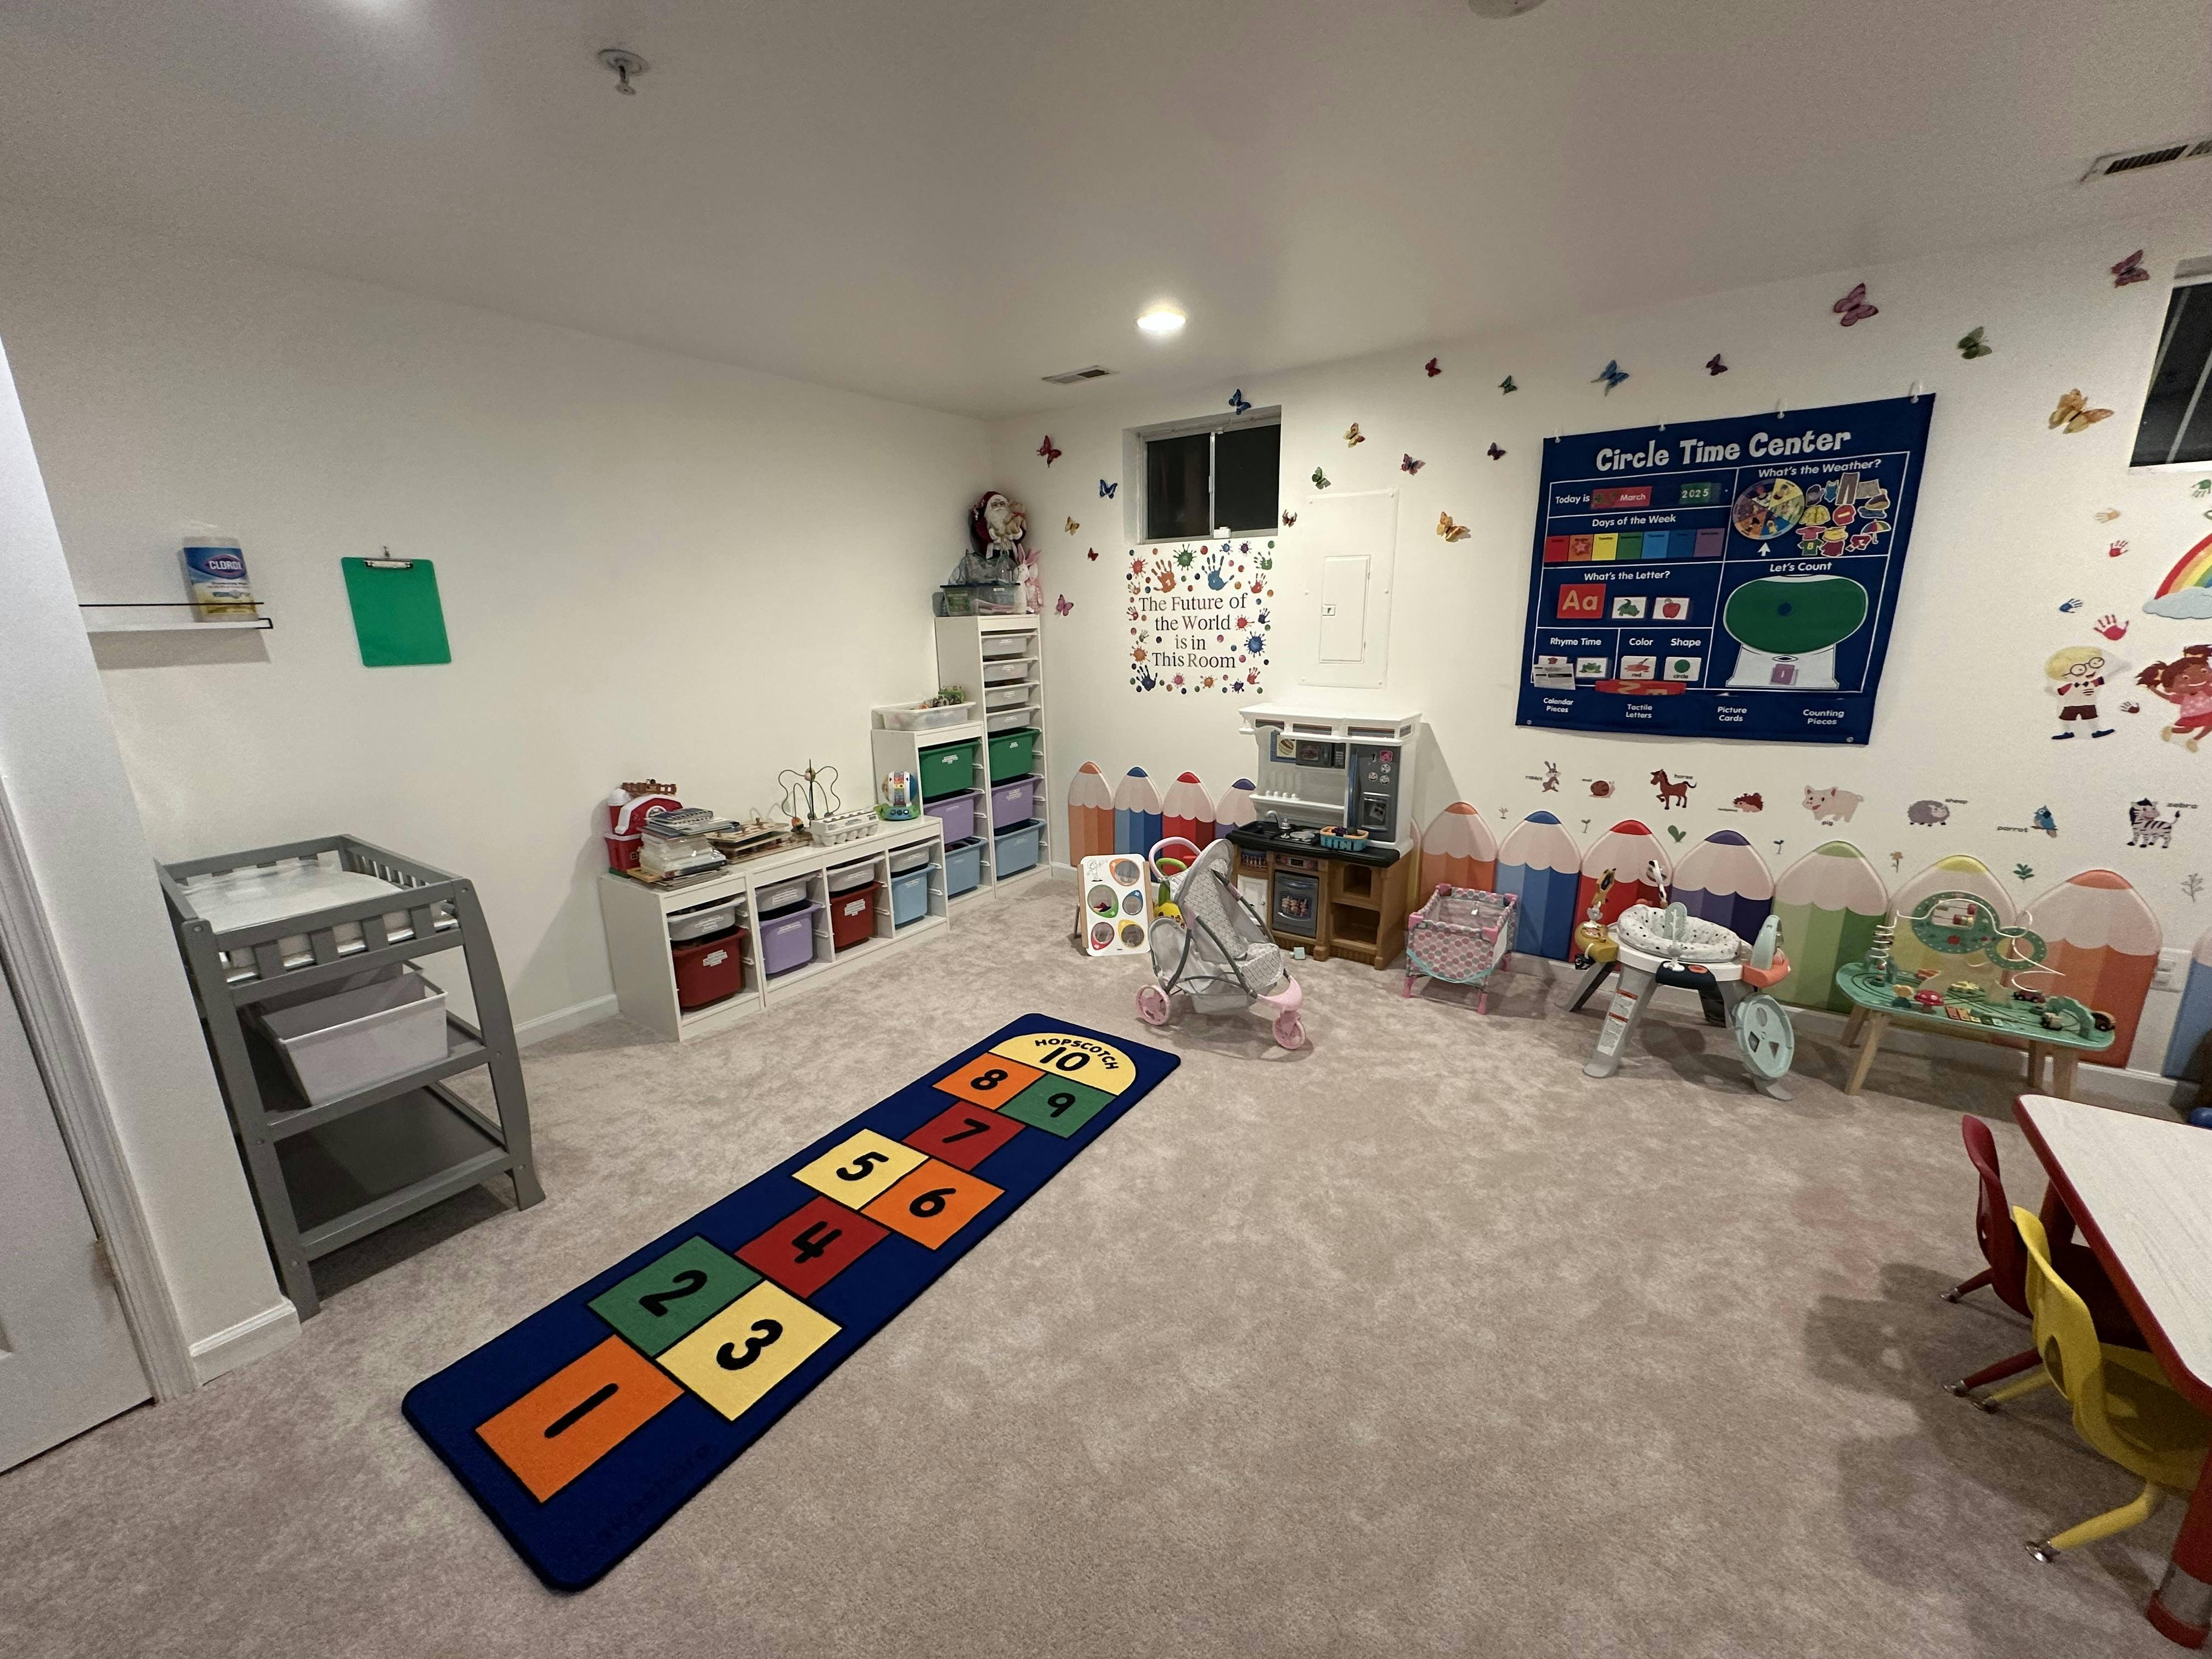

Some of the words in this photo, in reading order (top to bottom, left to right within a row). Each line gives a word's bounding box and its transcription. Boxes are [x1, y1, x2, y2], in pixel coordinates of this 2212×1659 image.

[1596, 439, 1669, 471] Circle
[1680, 439, 1741, 465] Time
[1749, 431, 1852, 457] Center
[1758, 467, 1797, 478] What's
[1800, 465, 1819, 475] the
[1822, 459, 1881, 473] Weather?
[1555, 495, 1581, 504] Today
[1583, 494, 1590, 503] is
[1681, 489, 1709, 498] 2025
[1592, 518, 1615, 528] Days
[1630, 516, 1646, 524] the
[1649, 514, 1677, 523] Week
[1636, 571, 1671, 579] Letter?
[1769, 563, 1795, 573] Let's
[1797, 562, 1832, 572] Count
[1138, 596, 1167, 611] The
[1171, 596, 1223, 611] Future
[1229, 592, 1248, 609] of
[1562, 590, 1598, 611] Aa
[1155, 616, 1178, 631] the
[1182, 614, 1231, 630] World
[1175, 634, 1187, 649] is
[1192, 635, 1206, 650] in
[1550, 637, 1578, 647] Rhyme
[1581, 637, 1601, 646] Time
[1629, 637, 1654, 646] Color
[1671, 638, 1701, 648] Shape
[1152, 652, 1184, 667] This
[1187, 653, 1236, 668] Room
[1543, 697, 1573, 706] Calendar
[1803, 709, 1844, 718] Counting
[1035, 1038, 1119, 1069] HOPSCOTCH
[1039, 1047, 1090, 1071] 10
[970, 1069, 1008, 1090] 8
[1047, 1092, 1076, 1118] 9
[941, 1118, 990, 1143] 7
[836, 1152, 889, 1181] 5
[909, 1188, 956, 1218] 6
[792, 1221, 842, 1264] 4
[638, 1269, 708, 1317] 2
[716, 1319, 783, 1370] 3
[544, 1383, 618, 1438] 1
